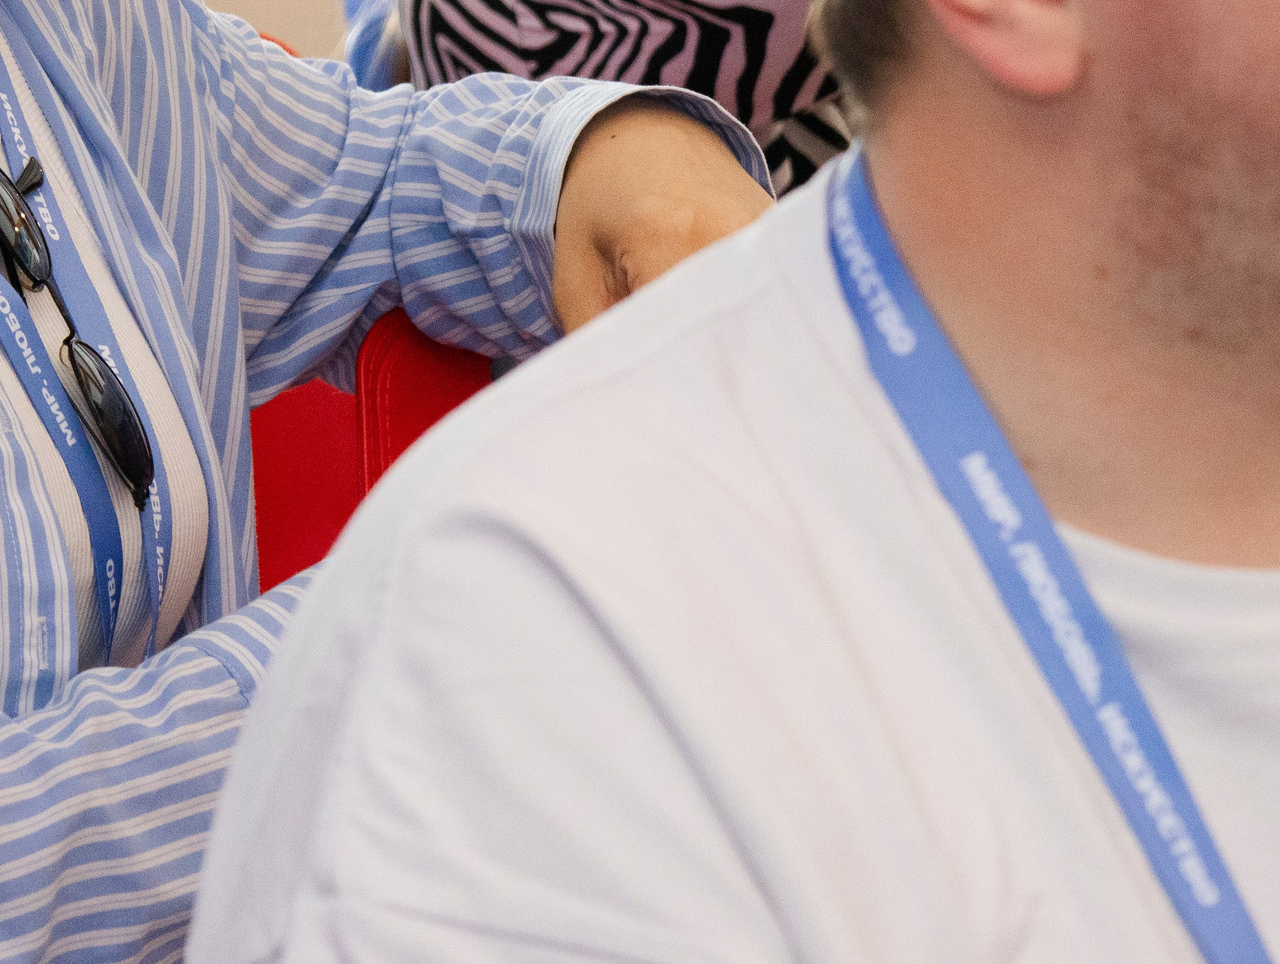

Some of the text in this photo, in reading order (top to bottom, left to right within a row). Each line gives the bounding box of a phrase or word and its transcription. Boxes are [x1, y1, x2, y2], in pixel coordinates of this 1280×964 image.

[0, 92, 60, 241] ИСКУТВО
[41, 378, 78, 447] МИР.
[1097, 701, 1221, 908] ИСКУССТВО
